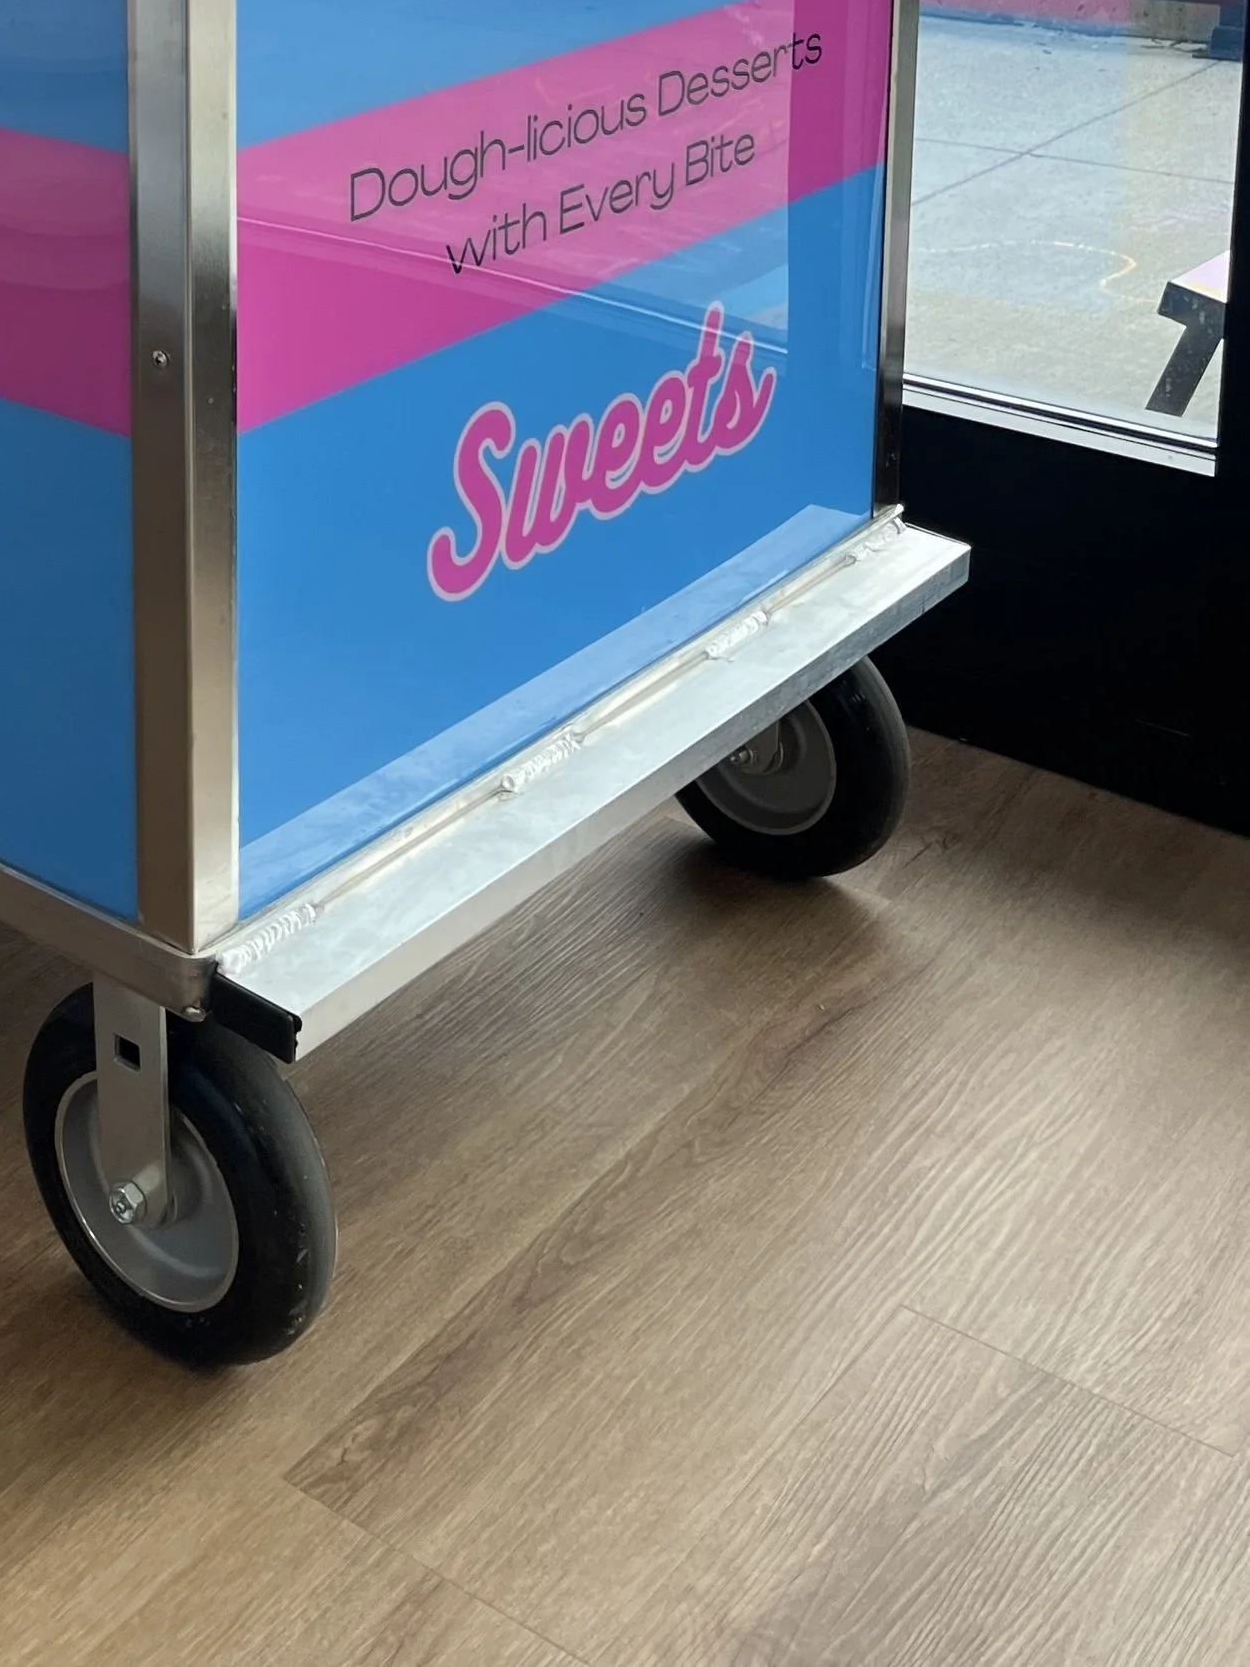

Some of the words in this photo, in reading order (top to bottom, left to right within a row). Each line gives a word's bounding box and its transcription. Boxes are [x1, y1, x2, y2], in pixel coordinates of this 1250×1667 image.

[350, 93, 647, 222] Dough-licious
[658, 32, 823, 116] Desserts
[446, 202, 547, 274] with
[559, 163, 675, 234] Every
[685, 133, 756, 187] Bite
[427, 301, 777, 602] Sweets
